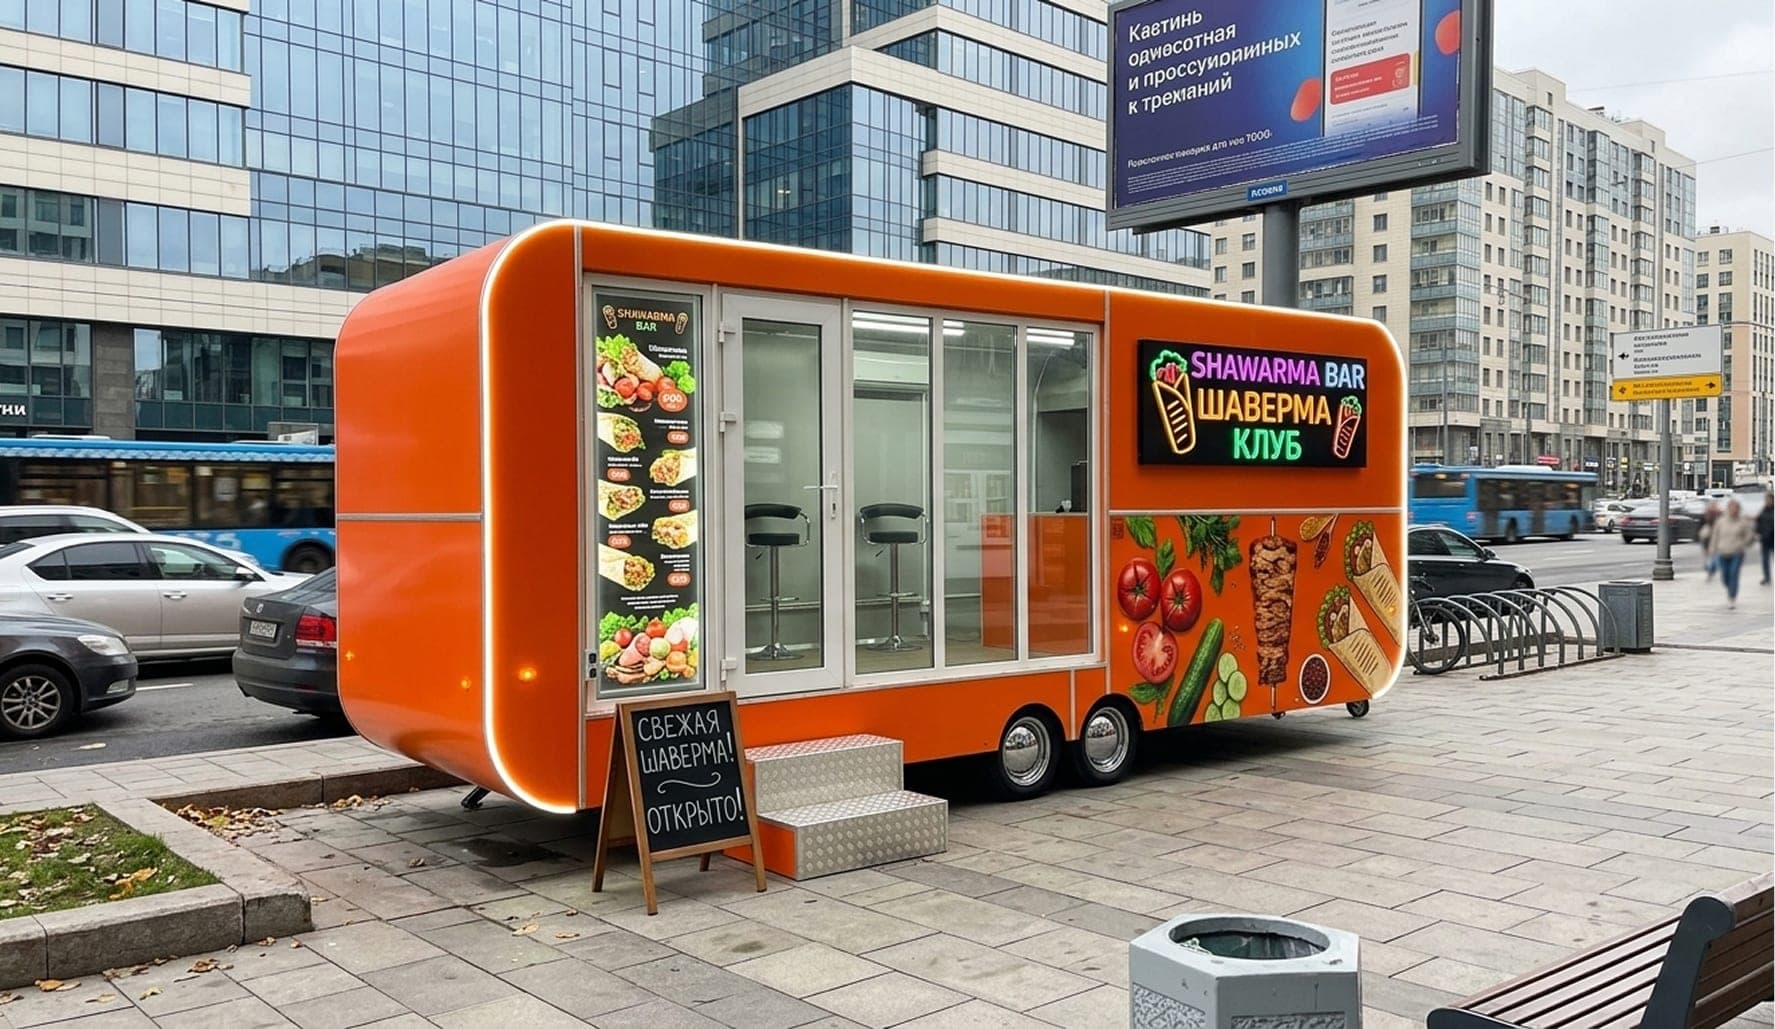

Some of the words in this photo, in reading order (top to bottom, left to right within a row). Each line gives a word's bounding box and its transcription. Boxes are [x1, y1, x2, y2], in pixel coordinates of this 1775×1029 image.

[1128, 76, 1139, 91] и
[1128, 101, 1138, 115] к
[635, 321, 657, 332] BAR
[1191, 350, 1321, 387] SHAWARMA
[1325, 361, 1365, 390] BAR
[0, 404, 26, 416] ни
[1197, 387, 1332, 426] ШАВЕРМА
[1233, 427, 1303, 461] КЛУБ
[637, 709, 720, 742] СВЕЖАЯ
[640, 731, 735, 774] ШАВЕРМА!
[647, 786, 744, 835] ОТКРЫТО!
